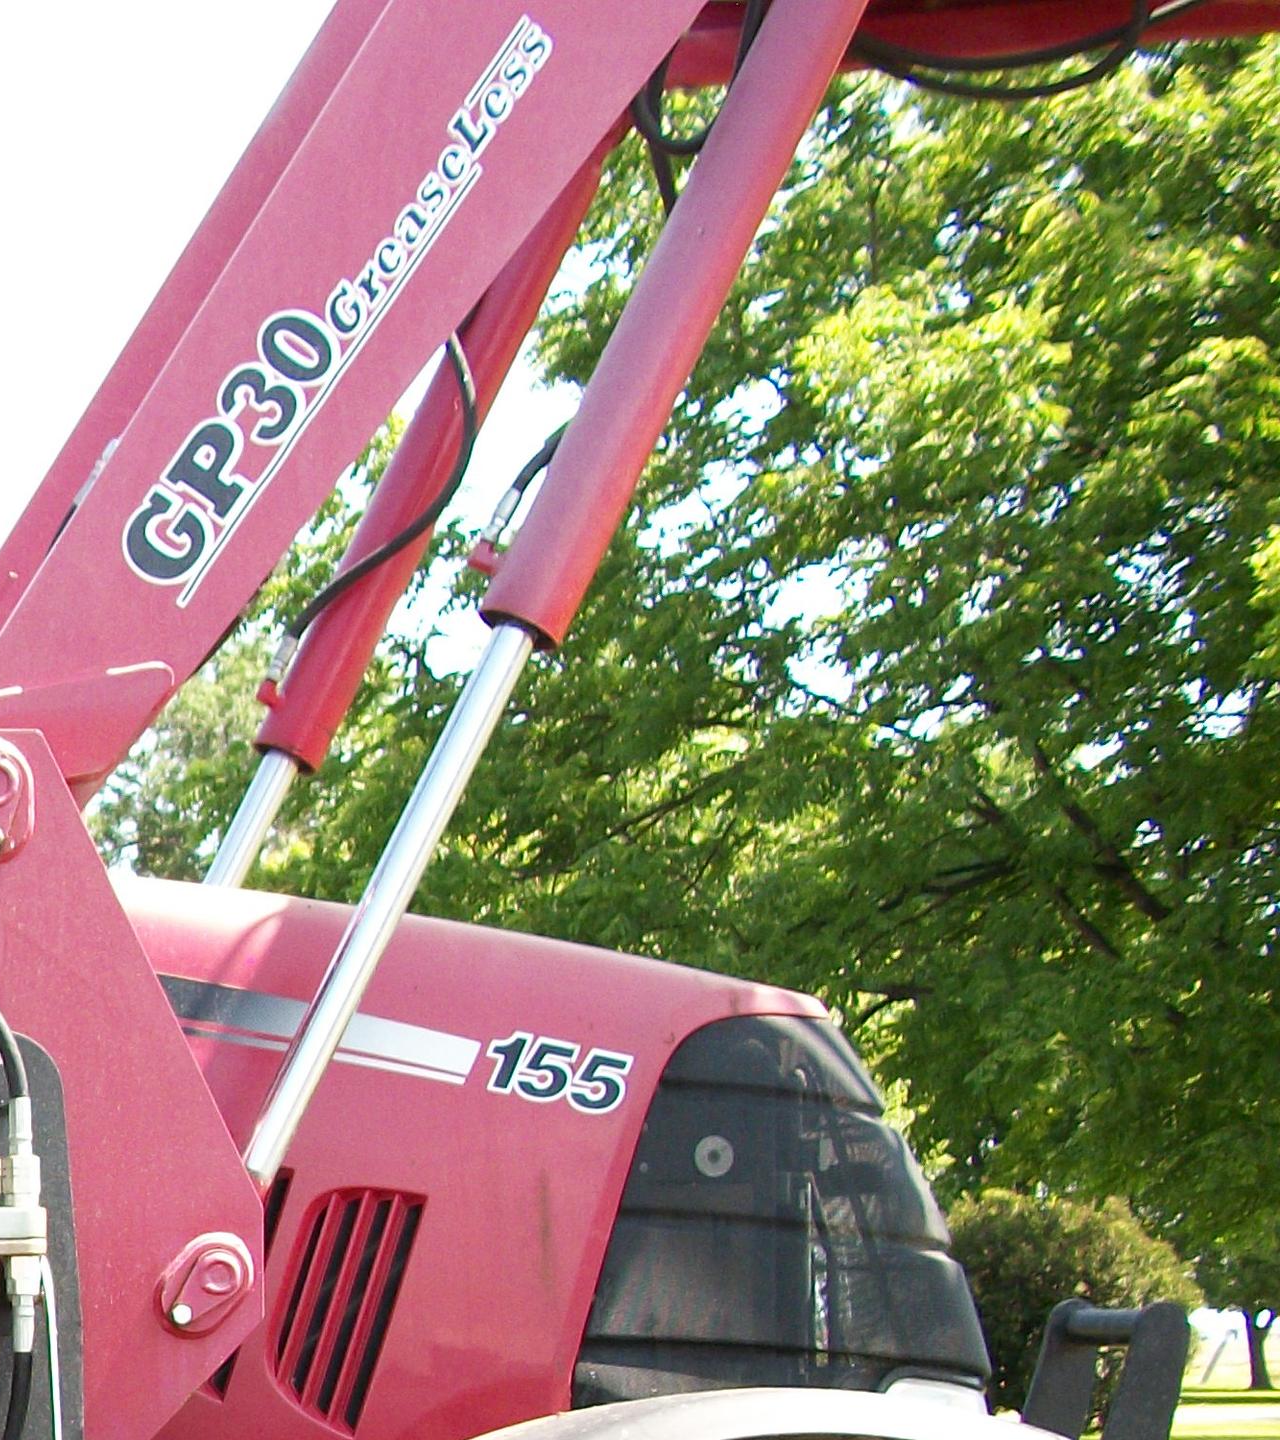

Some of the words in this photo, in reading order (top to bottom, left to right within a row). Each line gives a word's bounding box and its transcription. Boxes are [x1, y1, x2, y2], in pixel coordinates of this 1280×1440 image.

[123, 311, 339, 585] GP30
[326, 21, 553, 338] GreaseLess
[487, 1030, 633, 1115] 155
